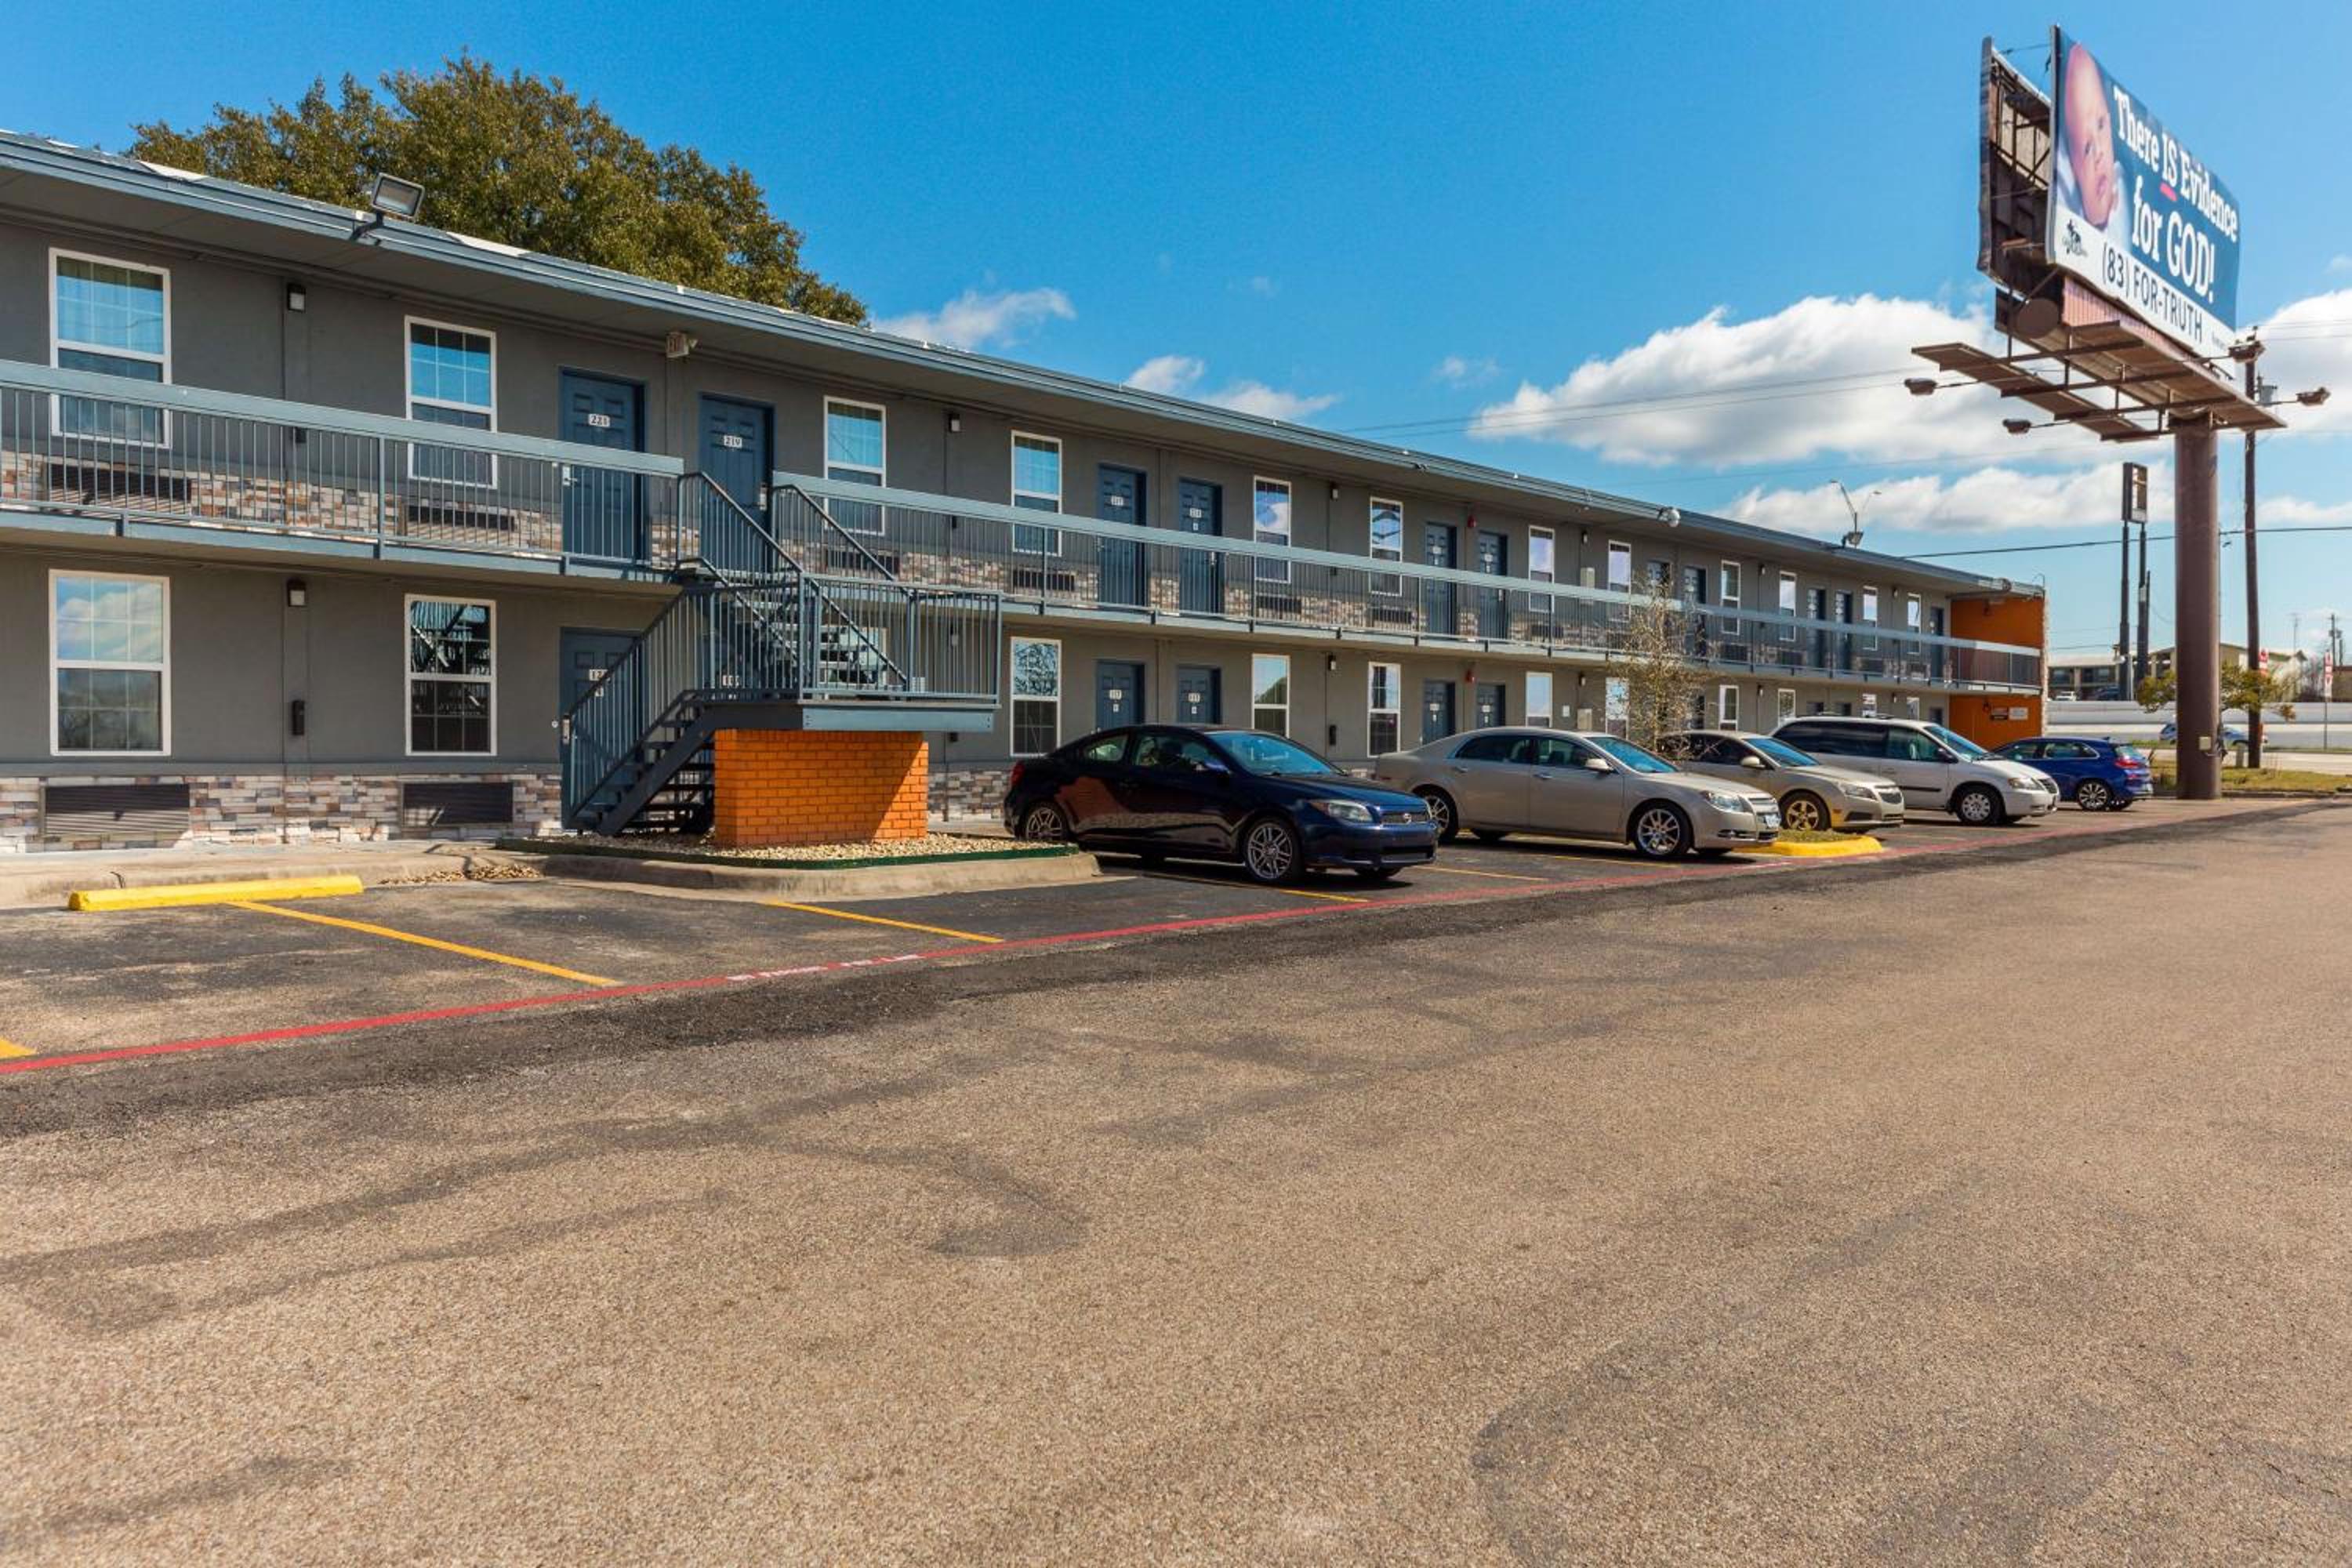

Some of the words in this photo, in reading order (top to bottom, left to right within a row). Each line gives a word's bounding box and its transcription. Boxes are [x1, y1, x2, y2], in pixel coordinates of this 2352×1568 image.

[2114, 85, 2160, 172] There
[2161, 132, 2177, 187] IS
[2180, 149, 2238, 243] Evidence
[2102, 241, 2130, 300] (83)
[2132, 263, 2203, 343] FOR-TRUTH
[2132, 175, 2163, 263] for
[2166, 210, 2216, 304] GOD!
